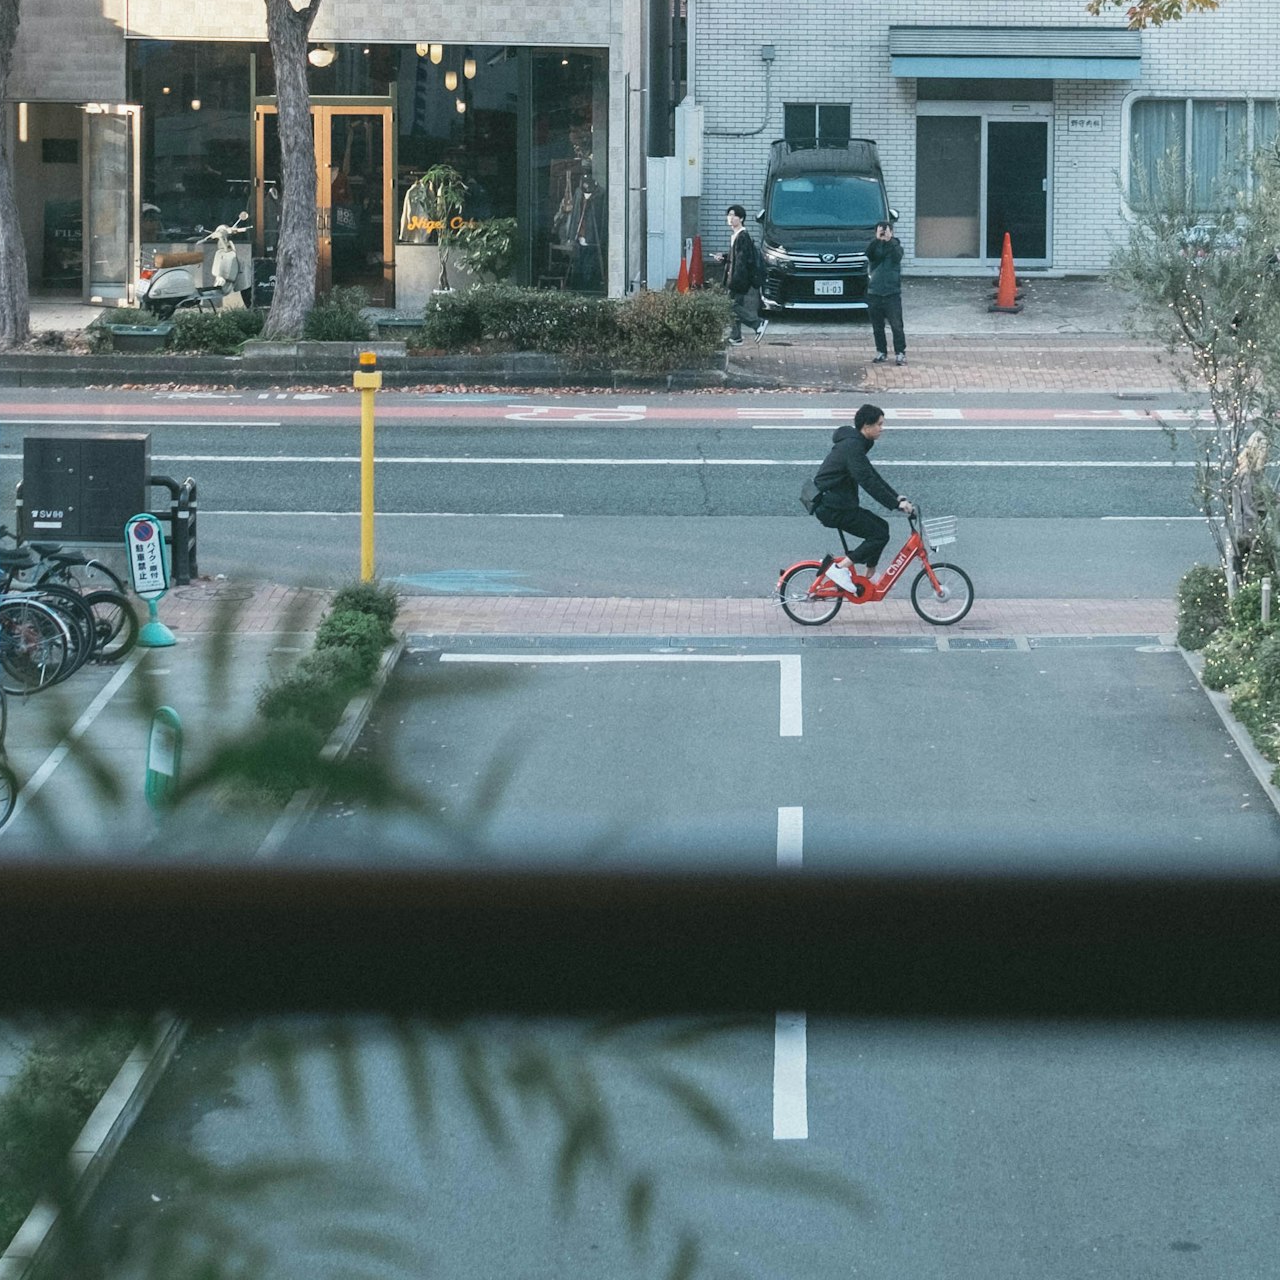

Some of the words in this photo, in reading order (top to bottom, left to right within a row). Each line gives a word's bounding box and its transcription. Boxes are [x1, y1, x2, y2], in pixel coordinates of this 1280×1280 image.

[135, 543, 148, 580] 駐車禁止
[886, 552, 907, 576] Chari
